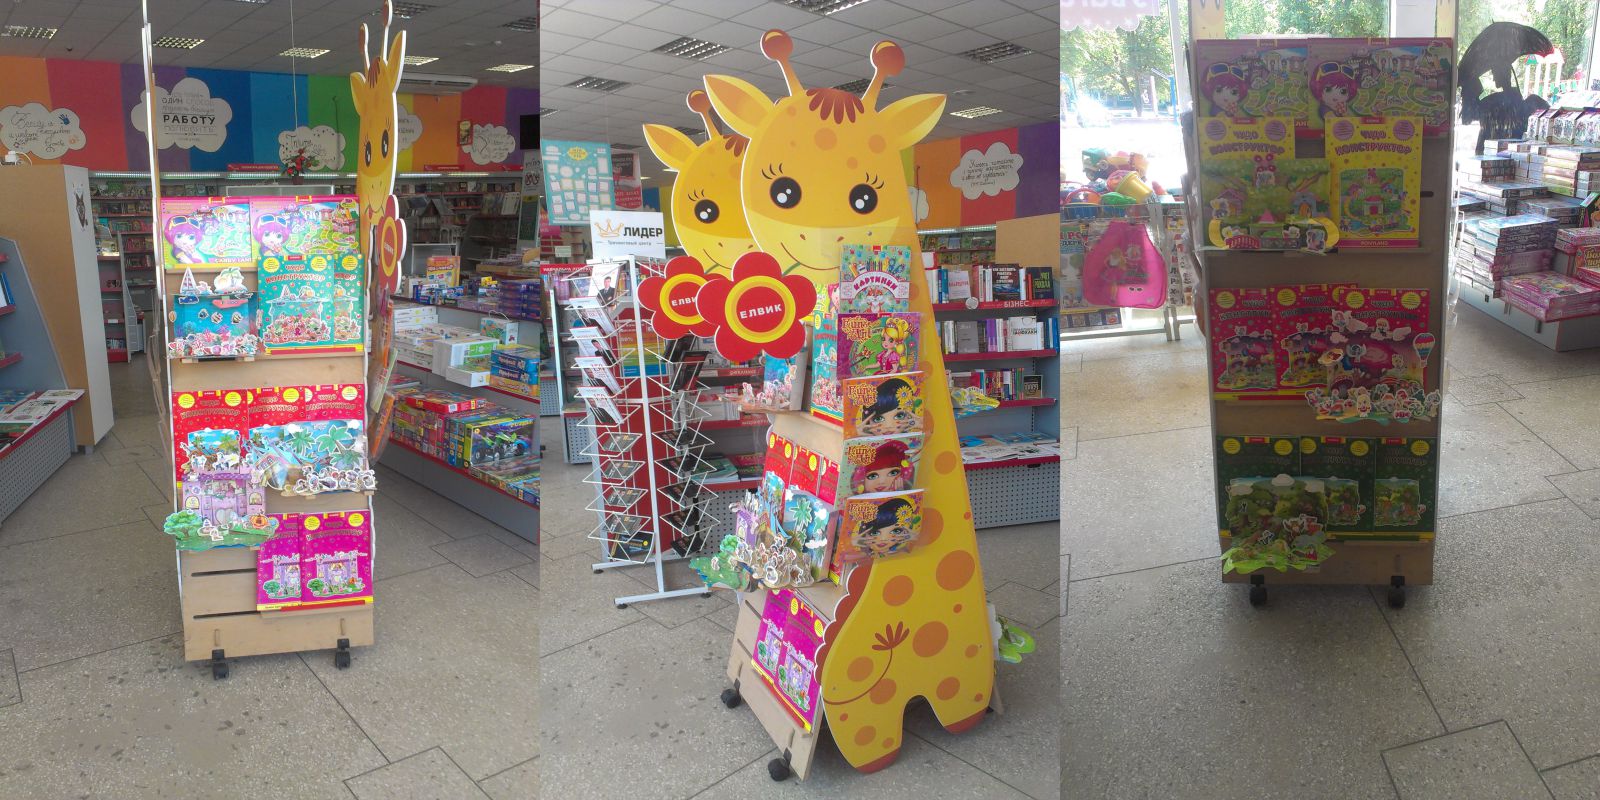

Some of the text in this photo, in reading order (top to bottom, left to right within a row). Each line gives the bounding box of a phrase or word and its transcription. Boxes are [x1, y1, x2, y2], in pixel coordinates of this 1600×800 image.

[163, 115, 216, 125] РАБОТУ
[623, 226, 663, 239] ЛИДЕР
[264, 273, 326, 284] КОНСТРУКТОР
[853, 276, 899, 291] КАРТИНКИ
[671, 296, 696, 307] ЕЛВИ
[1003, 300, 1029, 308] БІЗНЕС
[739, 303, 783, 319] ЕЛВИК
